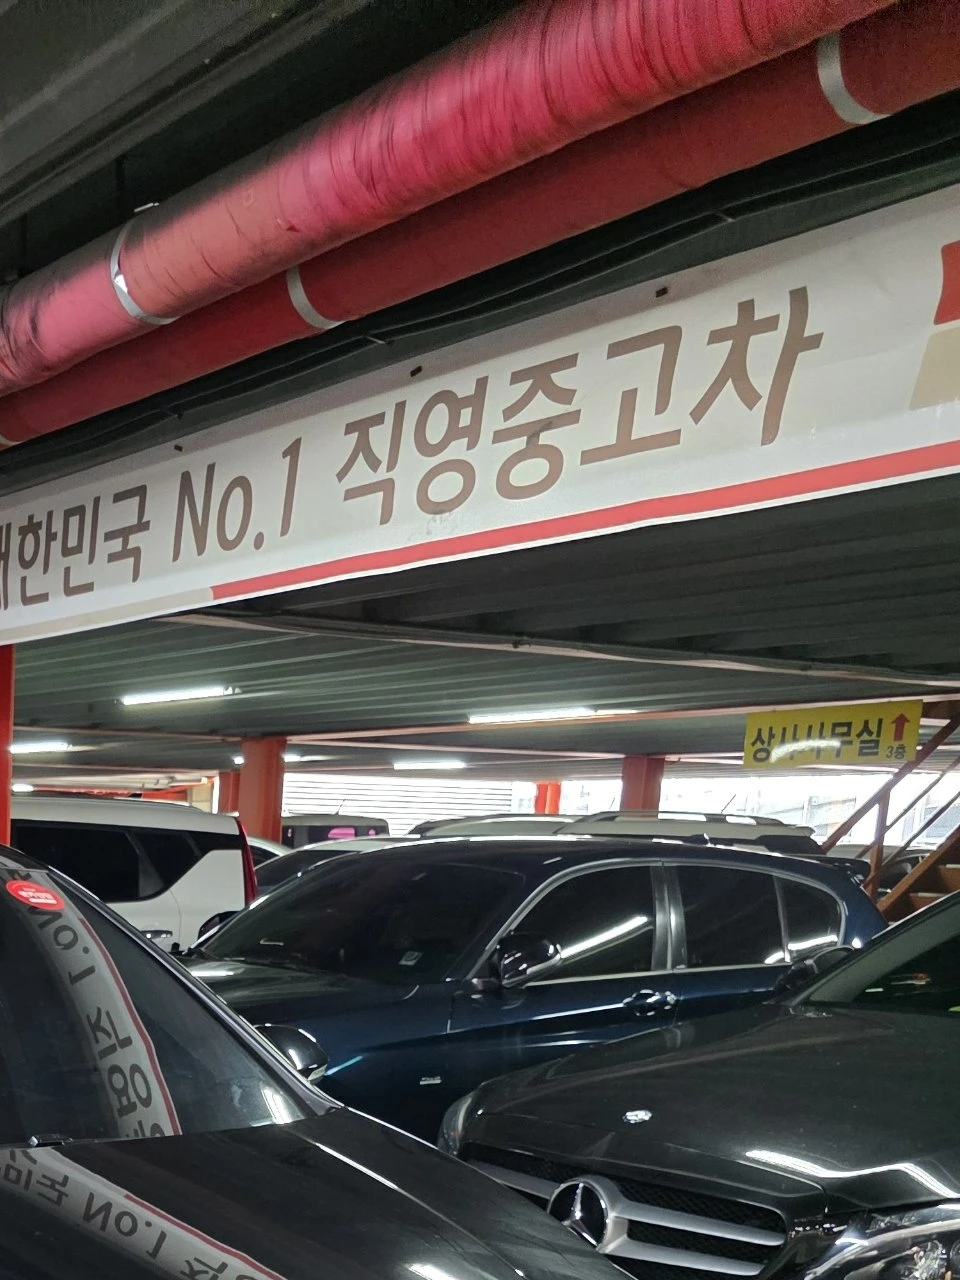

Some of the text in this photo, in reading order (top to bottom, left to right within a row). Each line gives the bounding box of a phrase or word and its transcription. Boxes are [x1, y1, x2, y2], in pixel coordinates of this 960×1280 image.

[172, 437, 302, 562] No.1
[335, 286, 825, 526] 직영중고차
[885, 744, 908, 761] 3층
